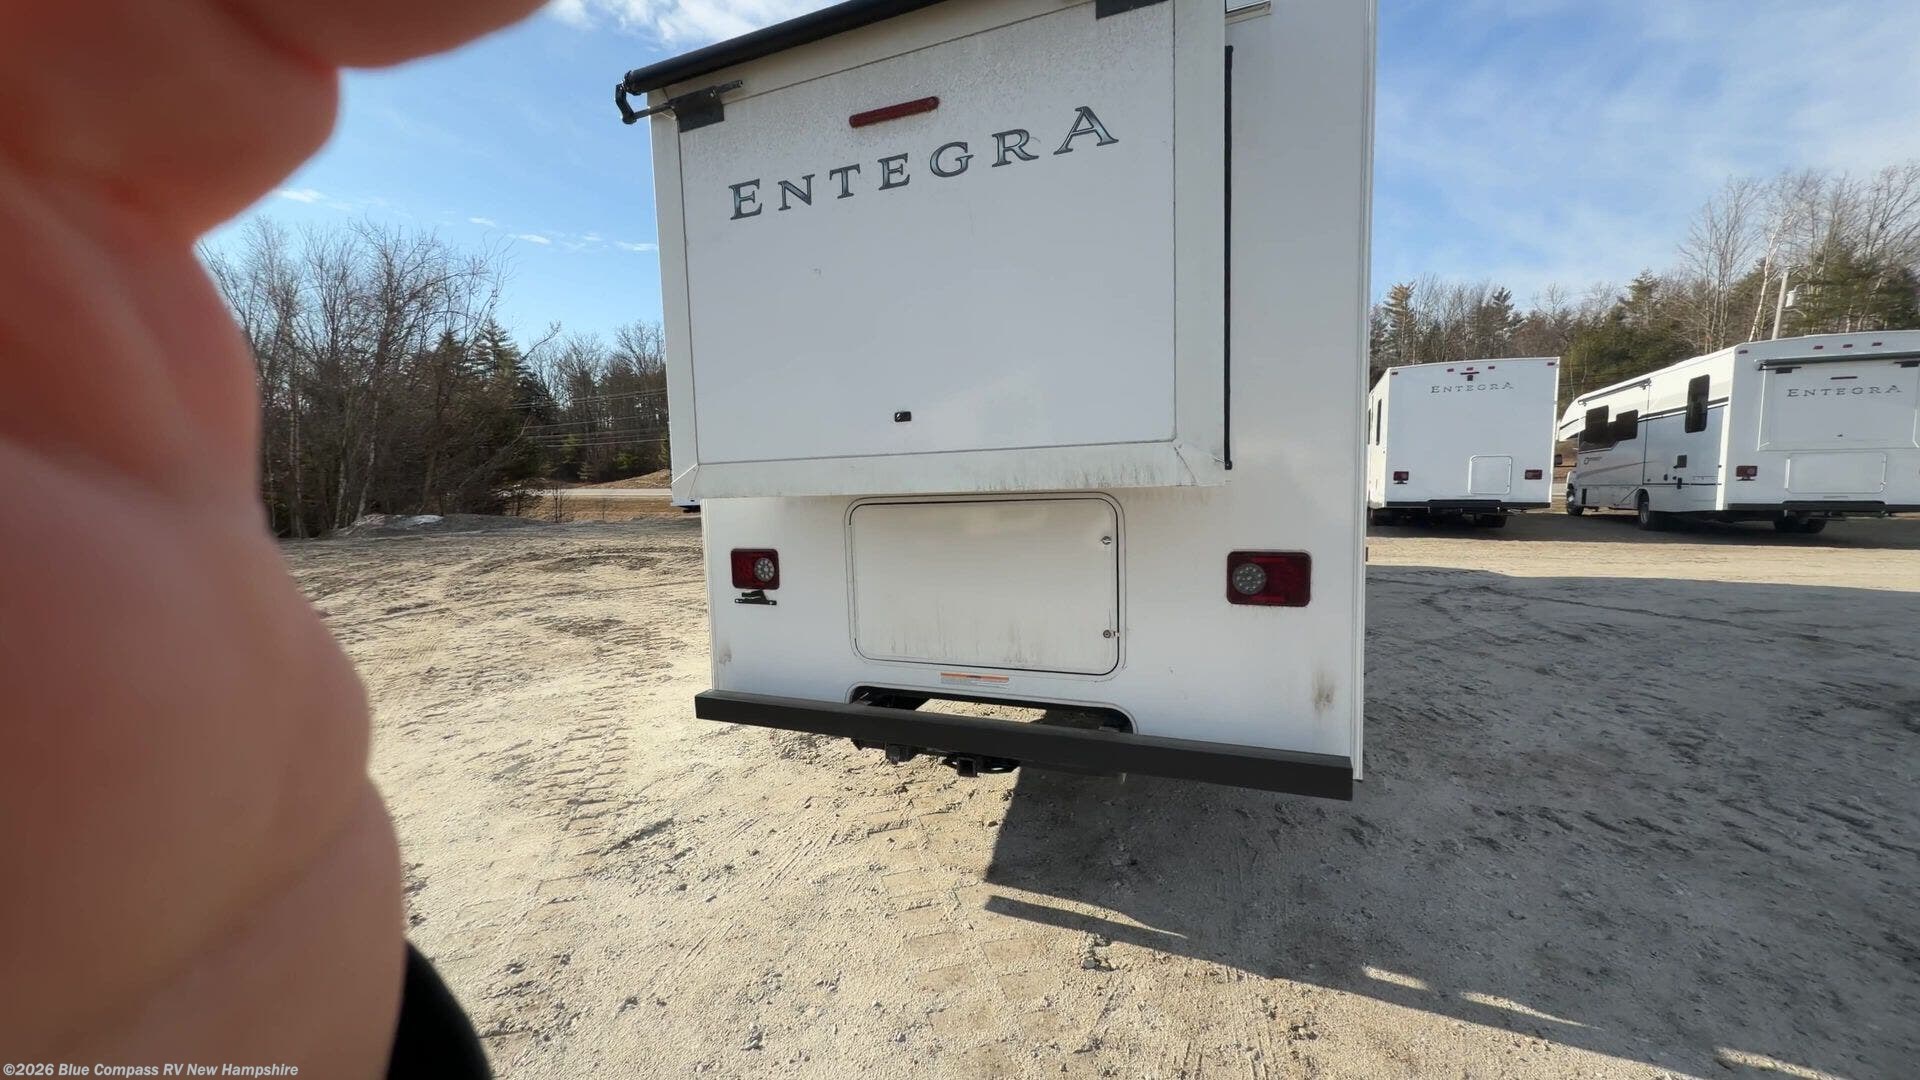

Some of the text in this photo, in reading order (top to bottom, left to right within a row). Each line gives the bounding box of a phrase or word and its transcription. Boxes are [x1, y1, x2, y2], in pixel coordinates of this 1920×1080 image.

[728, 105, 1119, 220] ENTEGRA
[1430, 382, 1514, 394] ENTEGRA
[1786, 385, 1902, 397] ENTEGRA
